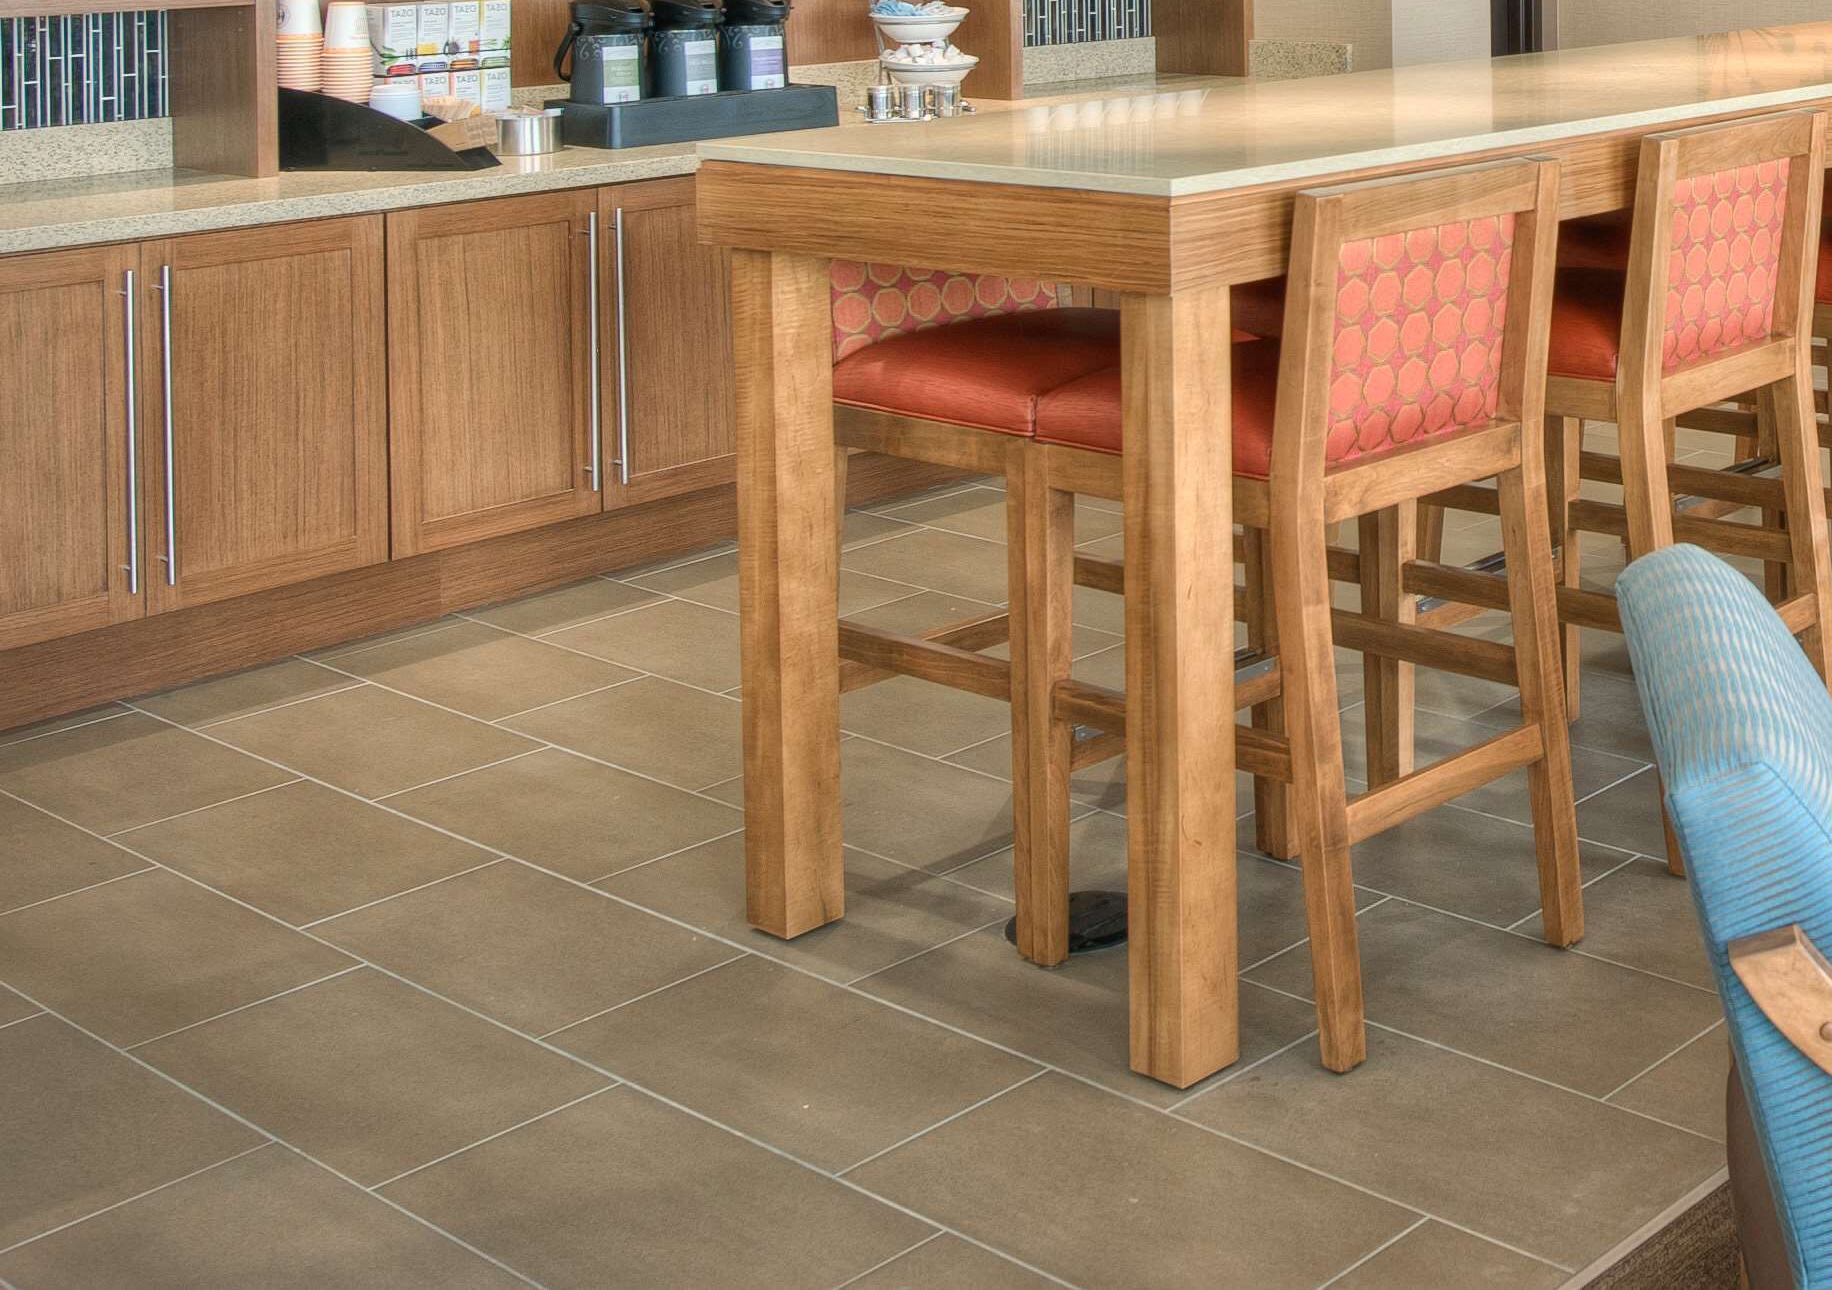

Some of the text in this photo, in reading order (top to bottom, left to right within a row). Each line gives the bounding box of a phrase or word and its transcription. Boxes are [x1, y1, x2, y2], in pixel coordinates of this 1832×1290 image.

[423, 7, 446, 16] TAZO
[455, 4, 477, 13] TAZO
[485, 3, 508, 12] TAZO
[391, 9, 414, 18] TAZO
[425, 76, 447, 85] TAZO
[456, 74, 478, 83] TAZO
[487, 72, 507, 81] TAZO
